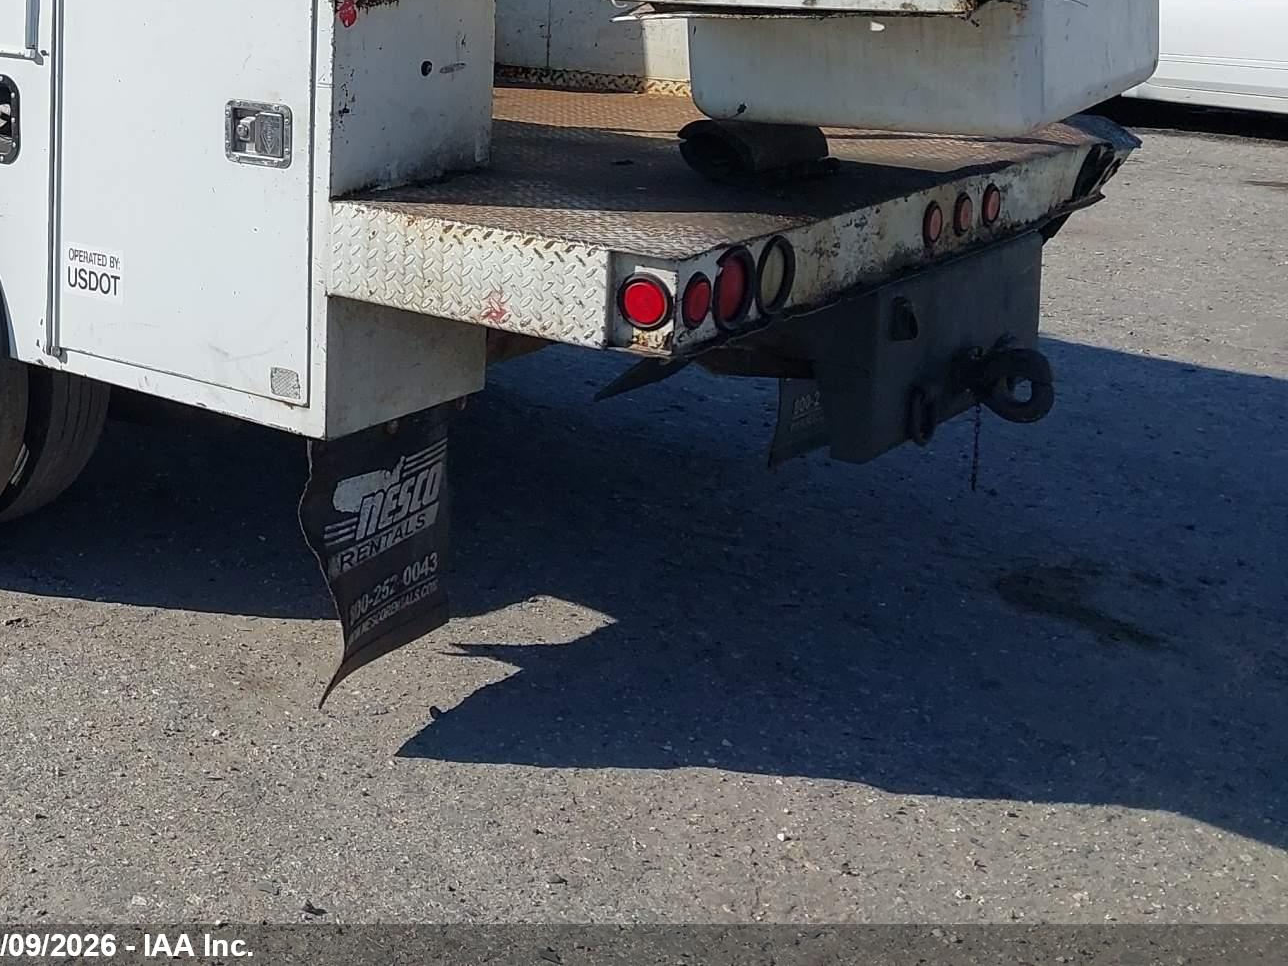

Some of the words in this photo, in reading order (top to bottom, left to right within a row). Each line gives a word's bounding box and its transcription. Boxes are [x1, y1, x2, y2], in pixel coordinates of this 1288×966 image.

[68, 247, 107, 267] OPERATED
[109, 255, 121, 271] BY:
[67, 265, 121, 296] USDOT
[340, 513, 427, 571] RENTALS
